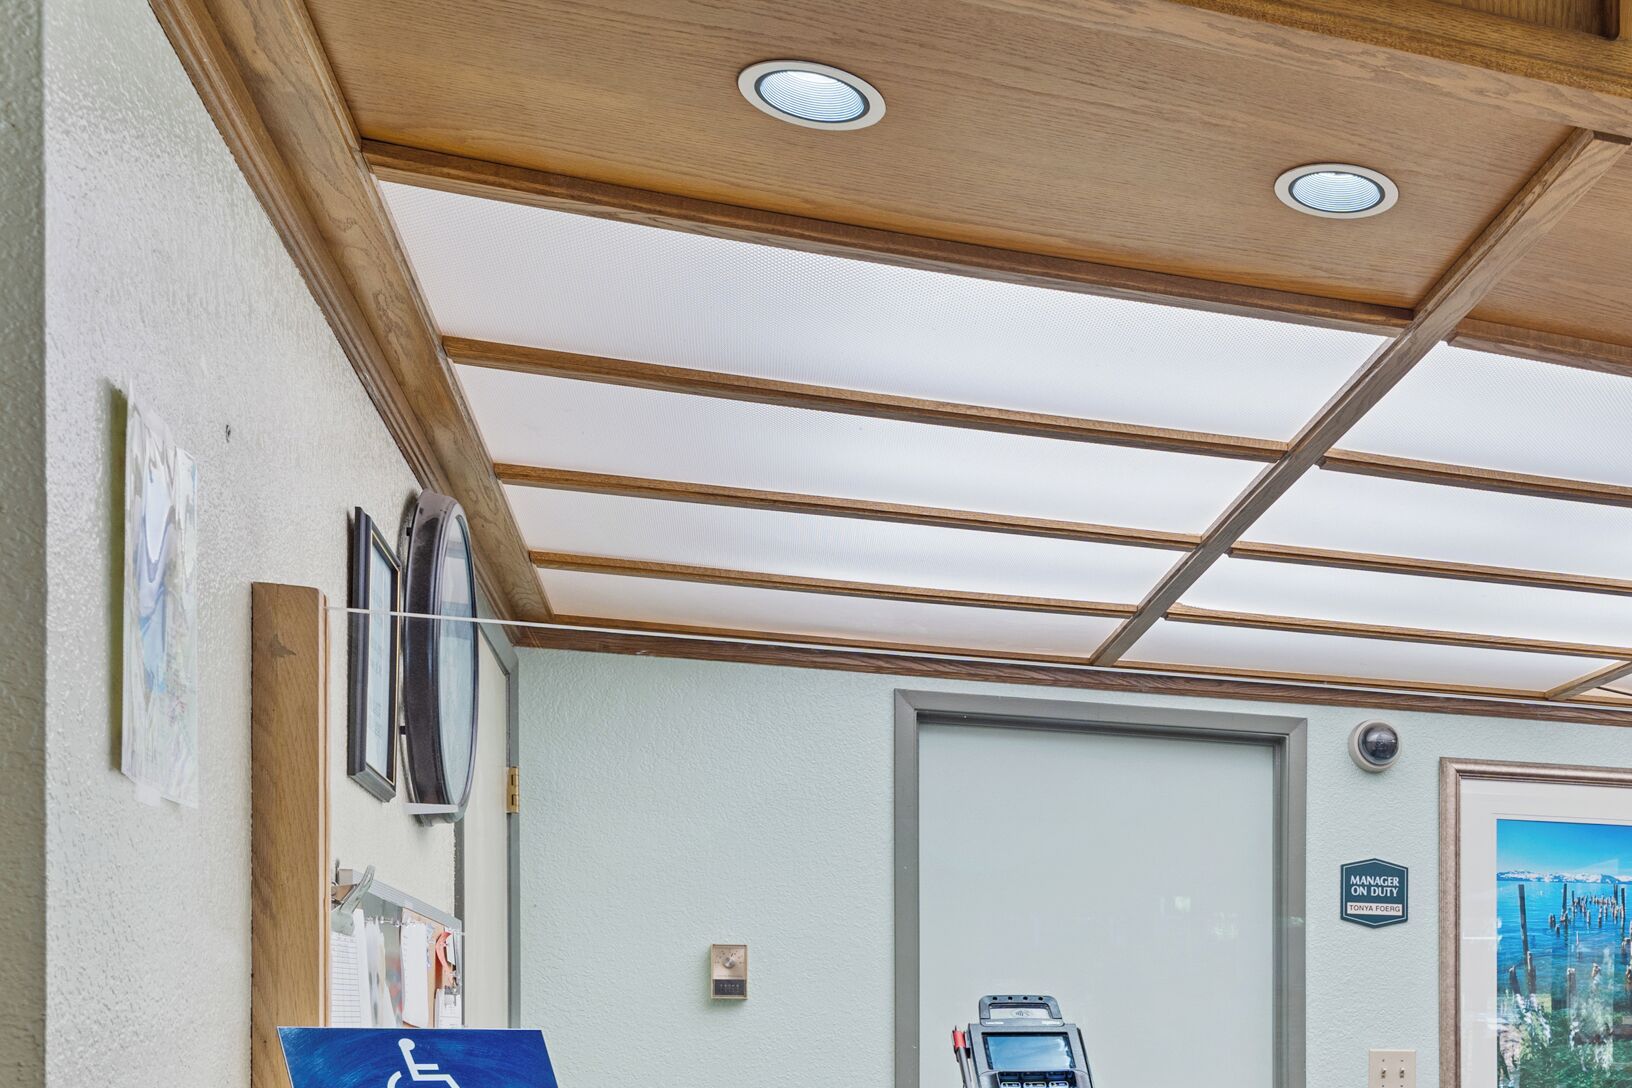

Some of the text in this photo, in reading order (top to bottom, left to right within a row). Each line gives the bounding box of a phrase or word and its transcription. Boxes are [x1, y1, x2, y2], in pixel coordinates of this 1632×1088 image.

[1350, 875, 1399, 886] MANAGER
[1351, 885, 1398, 897] ON DUTY
[1349, 904, 1373, 912] TONYA
